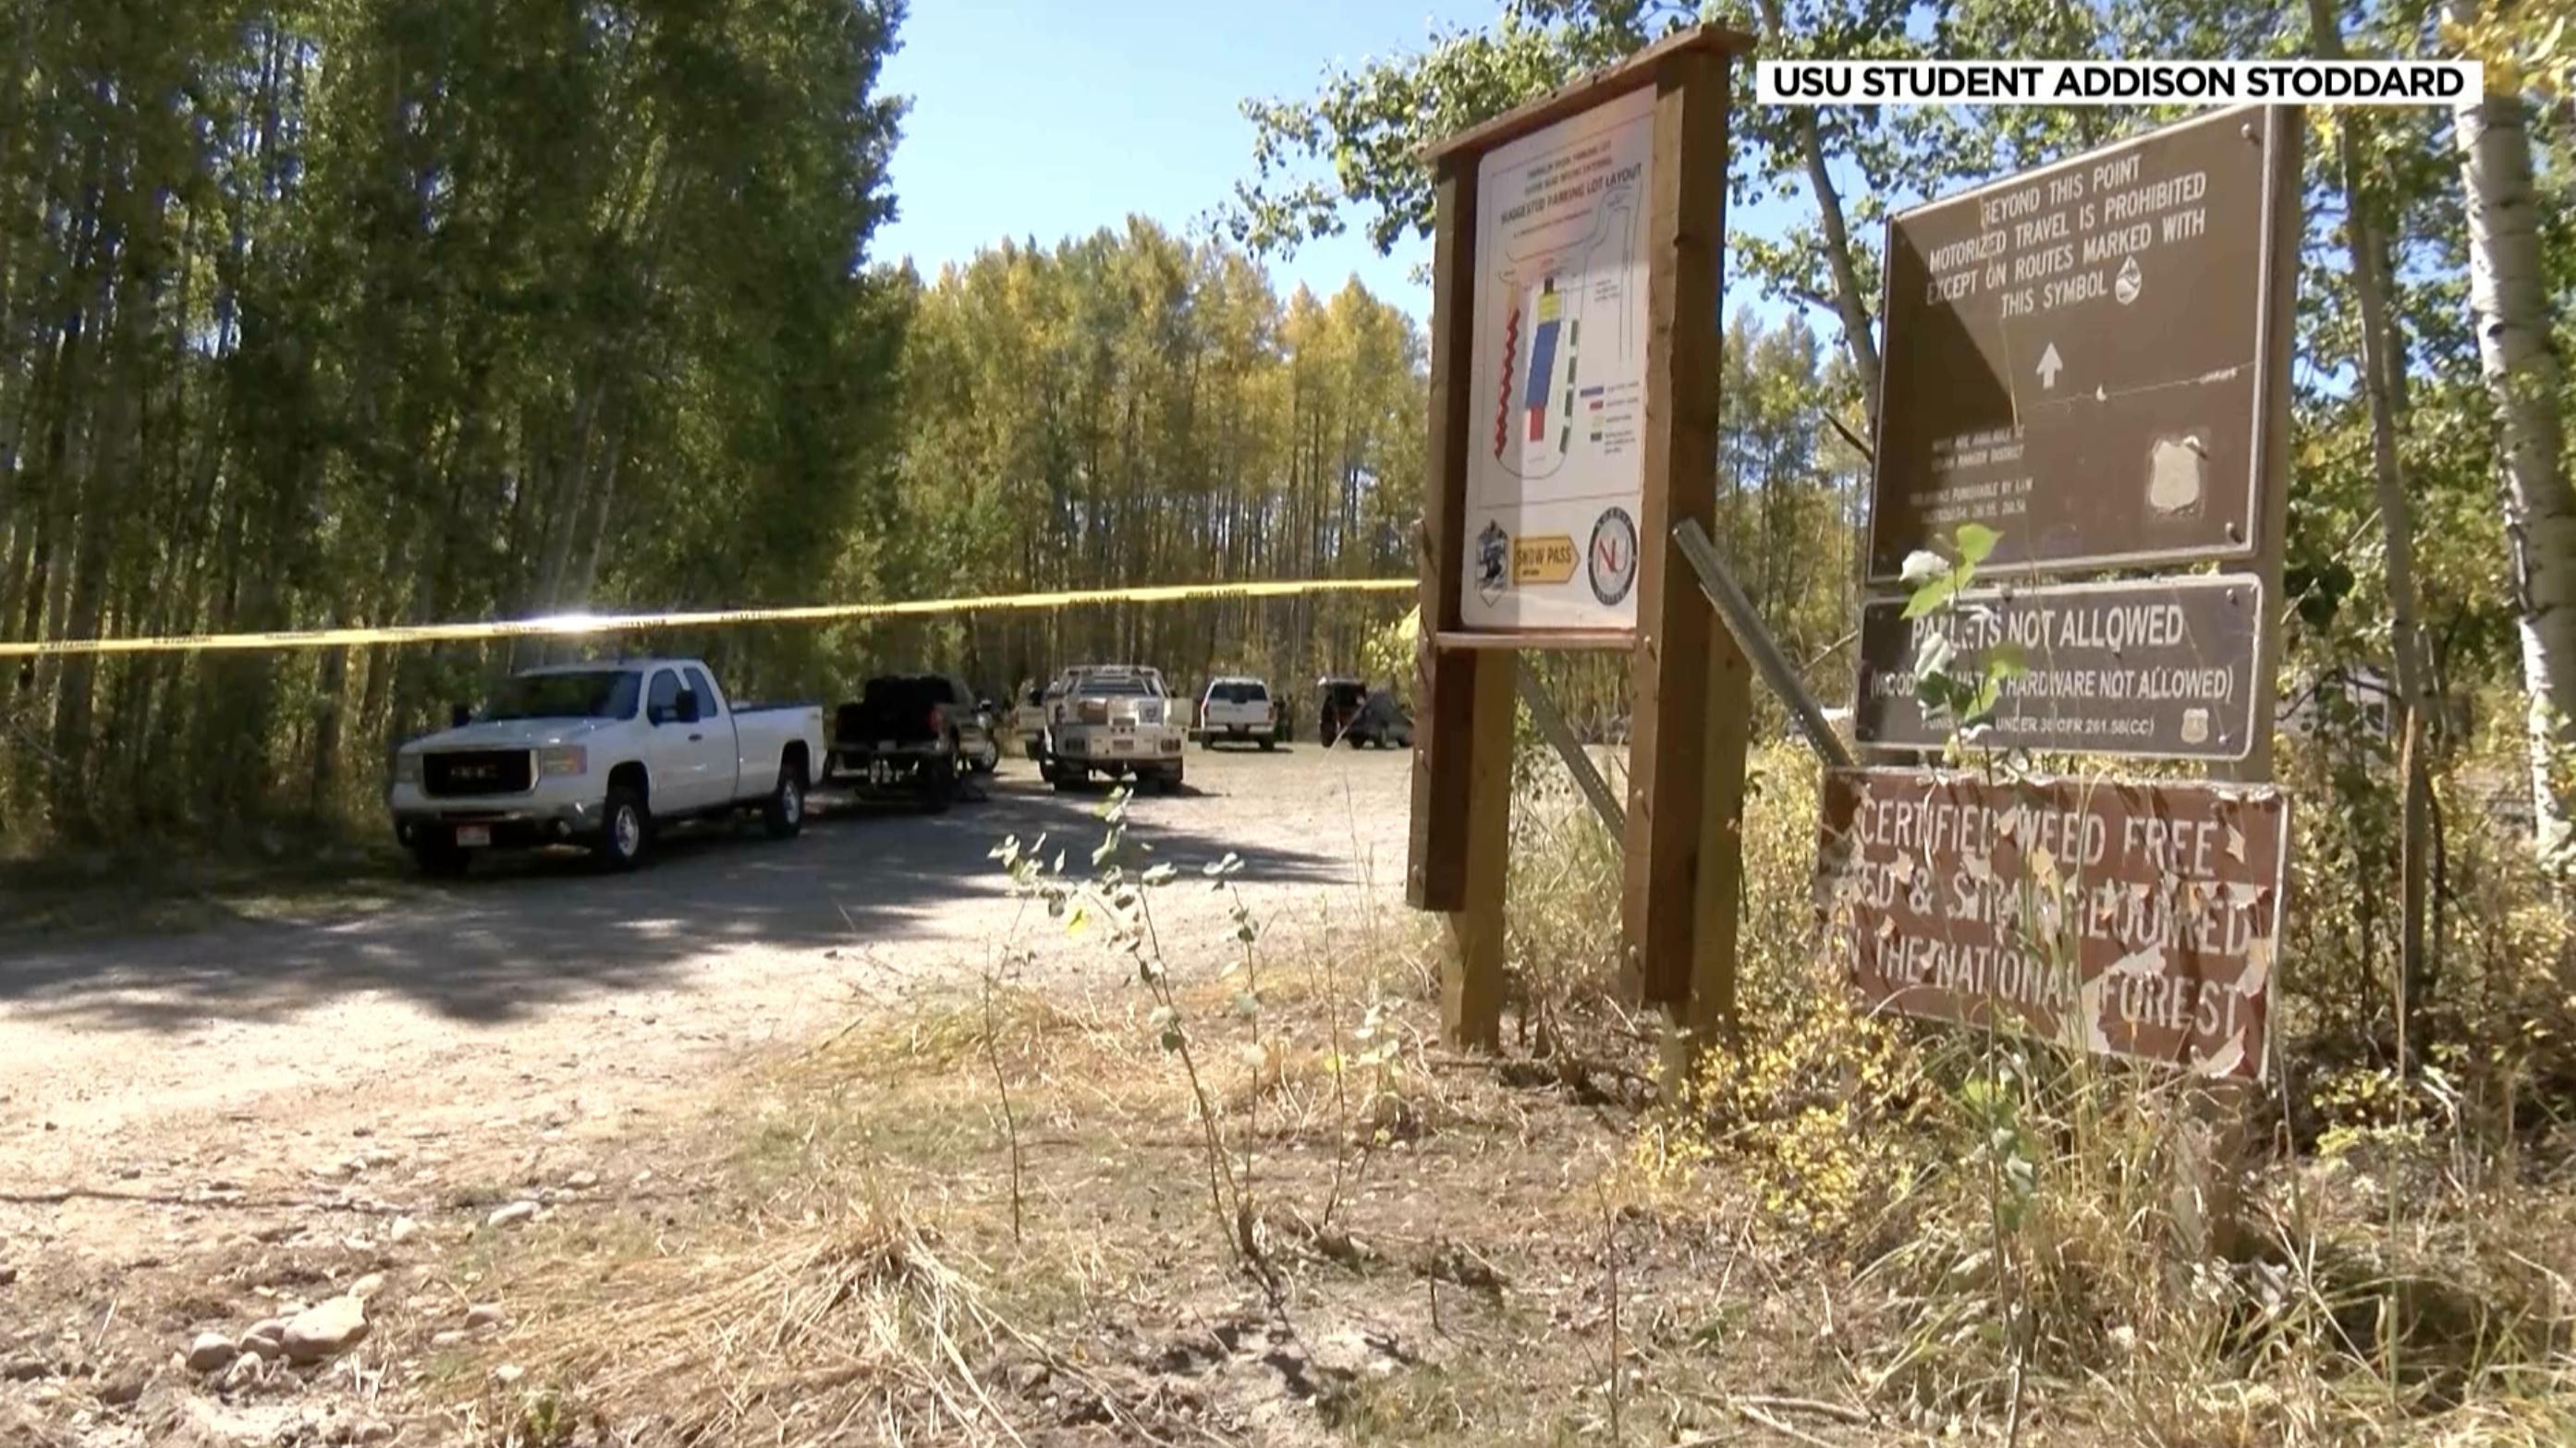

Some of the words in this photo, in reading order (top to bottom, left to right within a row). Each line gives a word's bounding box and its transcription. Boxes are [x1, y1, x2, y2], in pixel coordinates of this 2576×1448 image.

[1546, 184, 1585, 208] PARKING
[1587, 176, 1604, 194] LOT
[1605, 162, 1642, 187] LAYOUT
[1983, 188, 2040, 225] BEYOND
[2049, 174, 2083, 205] THIS
[2094, 153, 2142, 192] POINT
[1929, 230, 2006, 274] MOTORIZED
[2015, 213, 2069, 249] TRAVEL
[2080, 205, 2094, 229] IS
[2105, 171, 2206, 225] PROHIBITED
[1927, 268, 1978, 305] EXCEPT
[1986, 263, 2007, 289] ON
[2015, 245, 2073, 278] ROUTES
[2083, 222, 2151, 265] MARKED
[2163, 209, 2205, 243] WITH
[2001, 289, 2033, 319] THIS
[2044, 272, 2107, 309] SYMBOL
[1547, 545, 1571, 565] PASS
[2008, 610, 2055, 649] NOT
[2059, 604, 2184, 648] ALLOWED
[2007, 670, 2094, 698] HARDWARE
[2100, 670, 2134, 699] NOT
[2138, 666, 2233, 701] ALLOWED)
[1996, 717, 2037, 733] UNDER
[1860, 799, 1998, 855] CERTIFIED
[2016, 807, 2106, 867] WEED
[2124, 816, 2218, 879] FREE
[1909, 867, 1934, 916] &
[1874, 933, 1923, 983] THE
[2102, 969, 2241, 1040] FOREST
